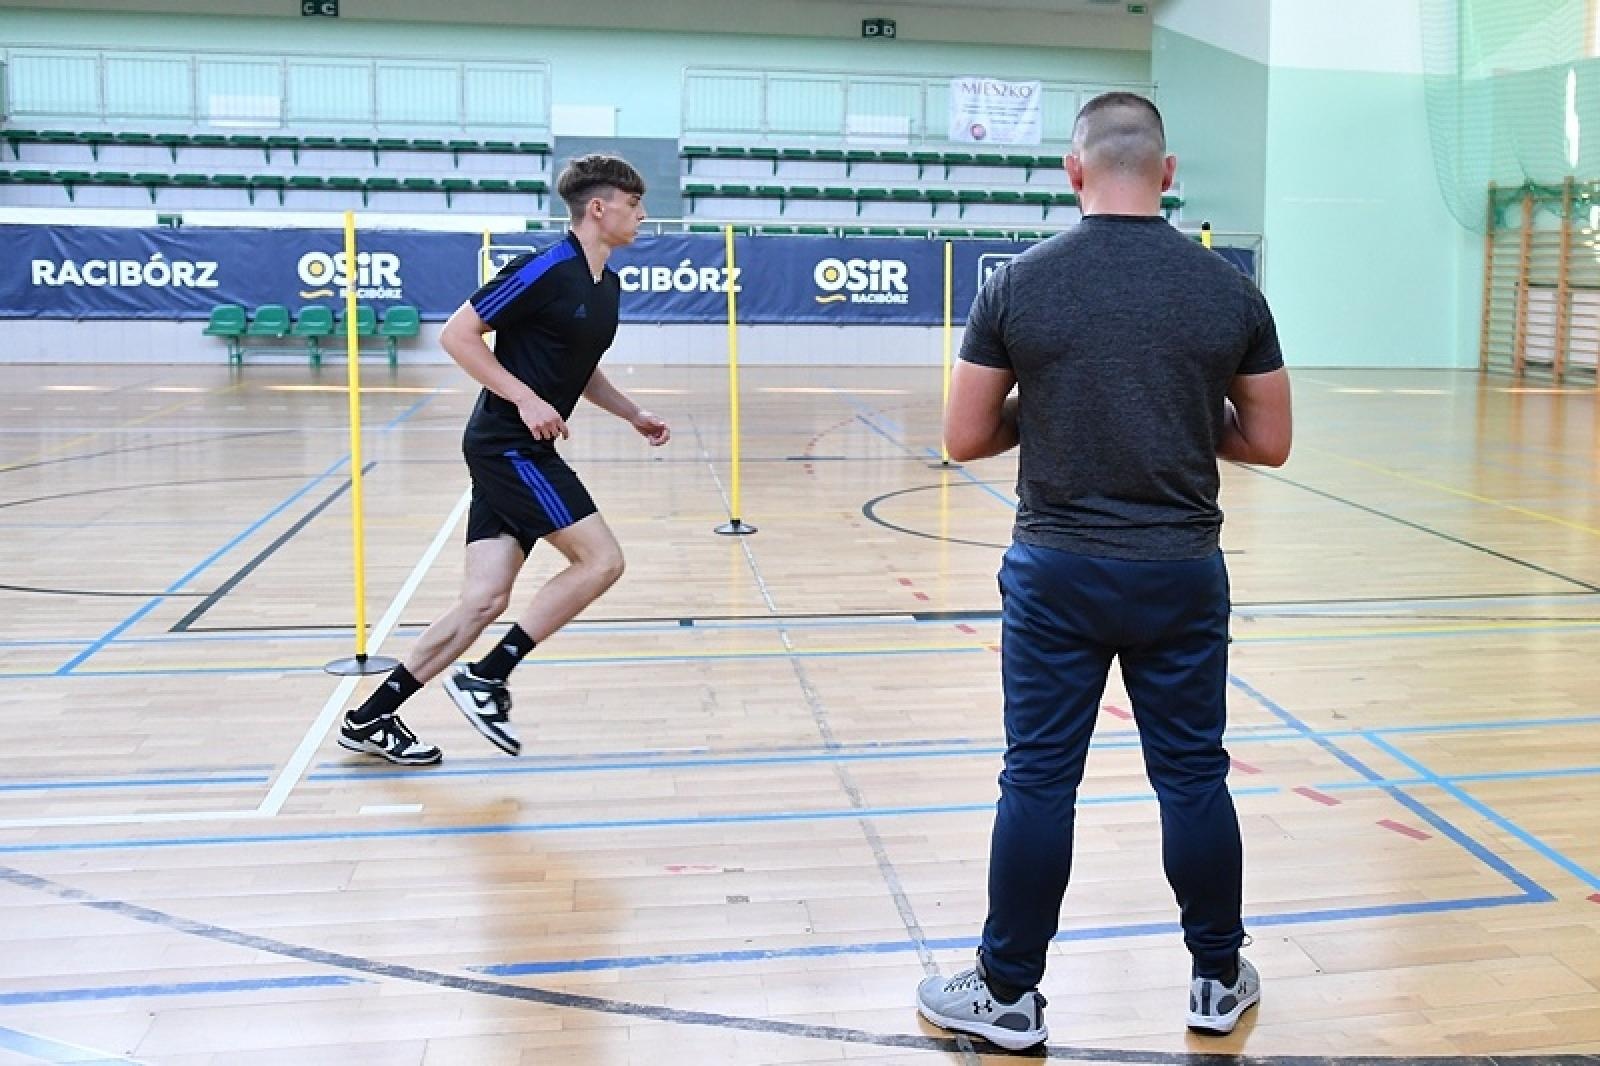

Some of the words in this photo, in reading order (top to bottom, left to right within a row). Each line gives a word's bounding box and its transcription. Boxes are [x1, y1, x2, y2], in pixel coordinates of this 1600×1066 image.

[303, 1, 314, 14] C
[321, 3, 335, 15] C
[31, 252, 219, 288] RACIBÓRZ
[617, 258, 742, 292] CIBÓRZ
[340, 286, 402, 299] RCIBÓRZ
[851, 292, 909, 304] RACIBÓRZ
